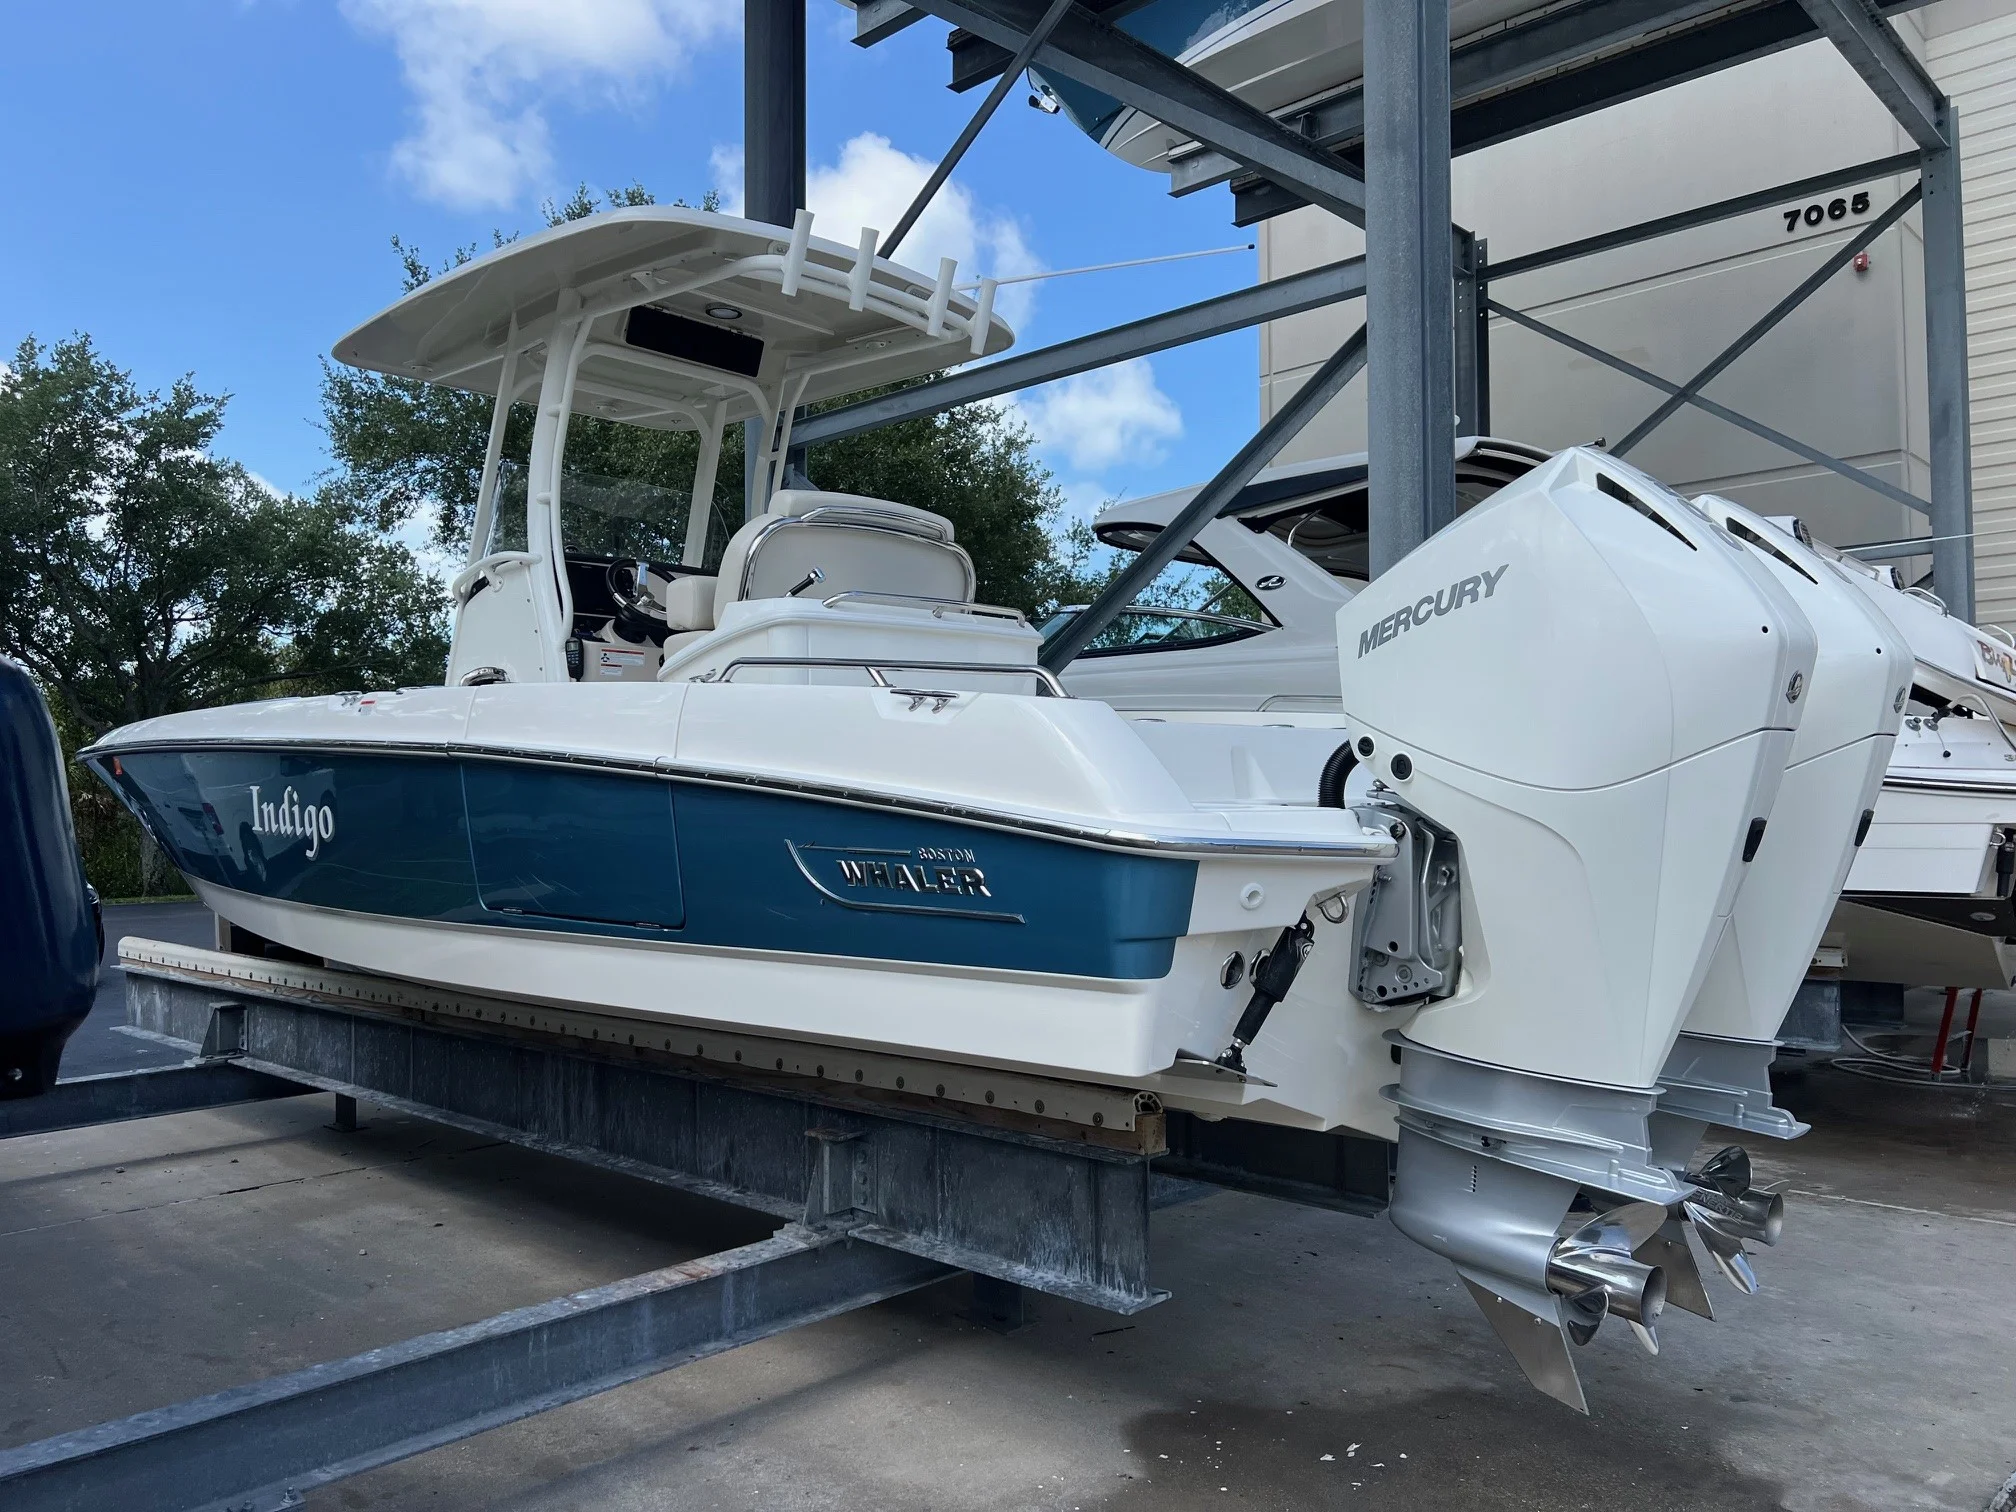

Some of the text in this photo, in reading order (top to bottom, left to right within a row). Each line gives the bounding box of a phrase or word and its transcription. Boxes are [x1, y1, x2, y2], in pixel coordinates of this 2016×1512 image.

[1783, 191, 1870, 232] 7065
[1357, 563, 1510, 660] MERCURY
[249, 785, 335, 859] Indigo
[918, 847, 976, 863] BOSTON
[836, 860, 992, 897] WHALER
